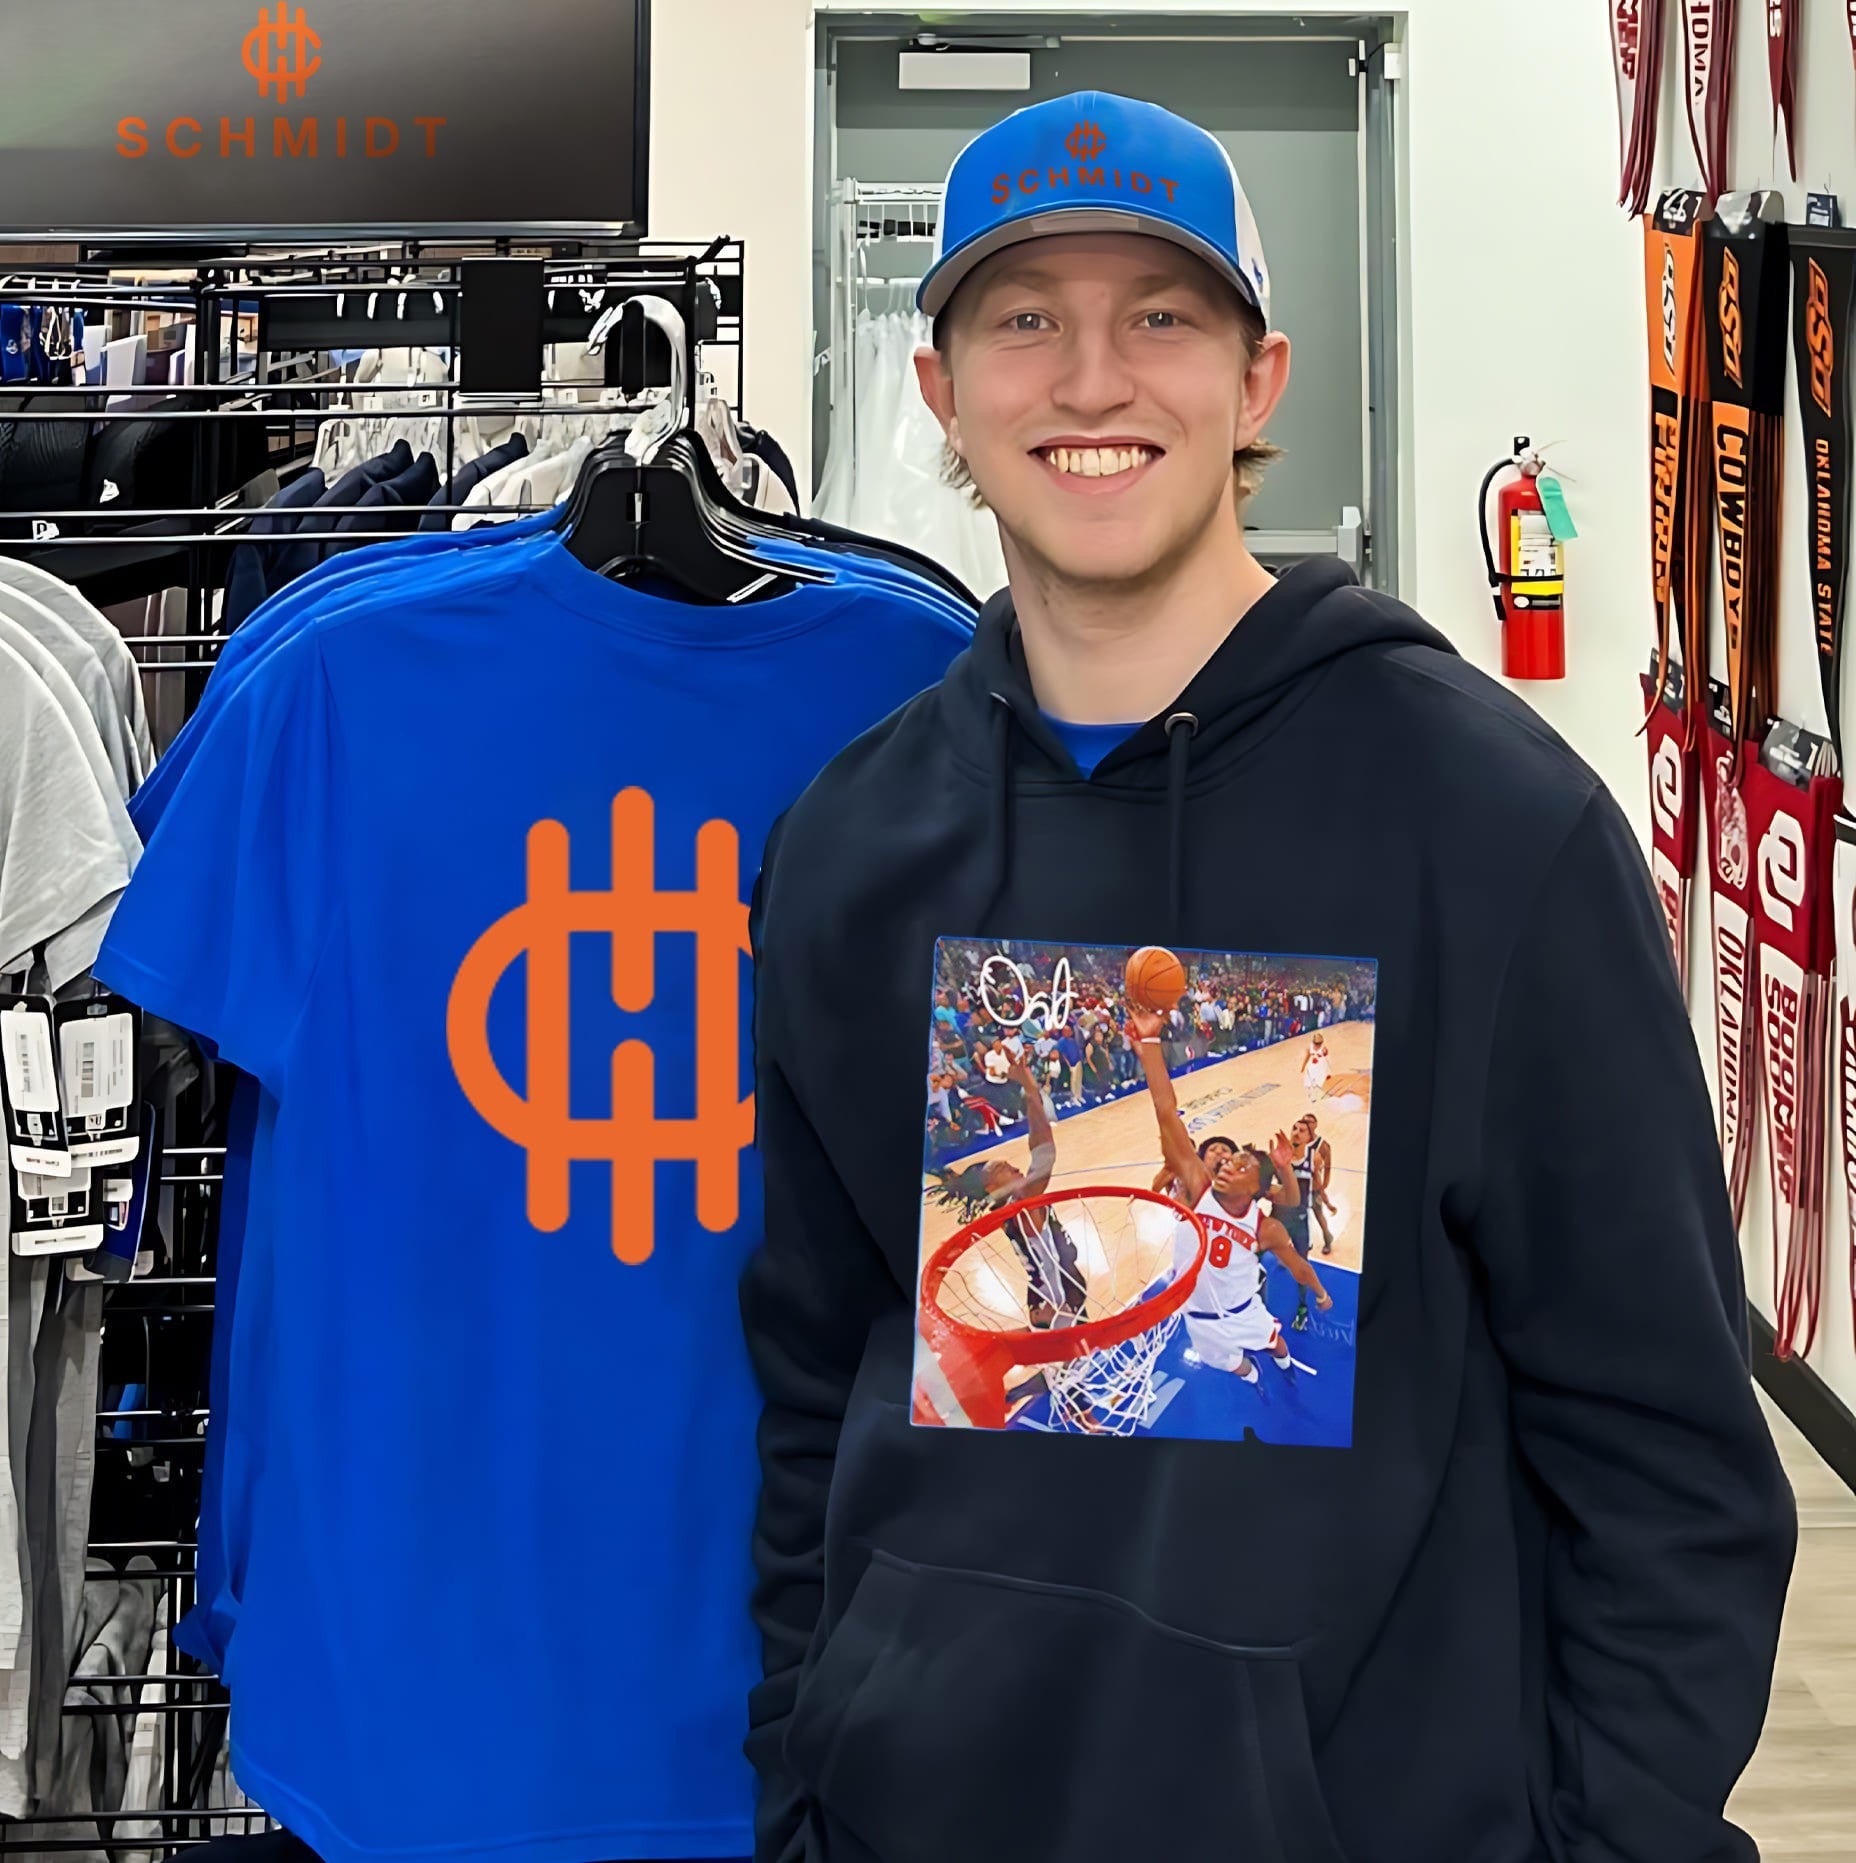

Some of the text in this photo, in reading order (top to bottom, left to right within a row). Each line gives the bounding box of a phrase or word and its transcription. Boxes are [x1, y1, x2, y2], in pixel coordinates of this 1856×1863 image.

[115, 115, 448, 160] SCHMIDT
[991, 166, 1180, 206] SCHMIDT
[1815, 438, 1833, 570] OKLAHOMA
[1717, 925, 1745, 1144] OKLAHOMA
